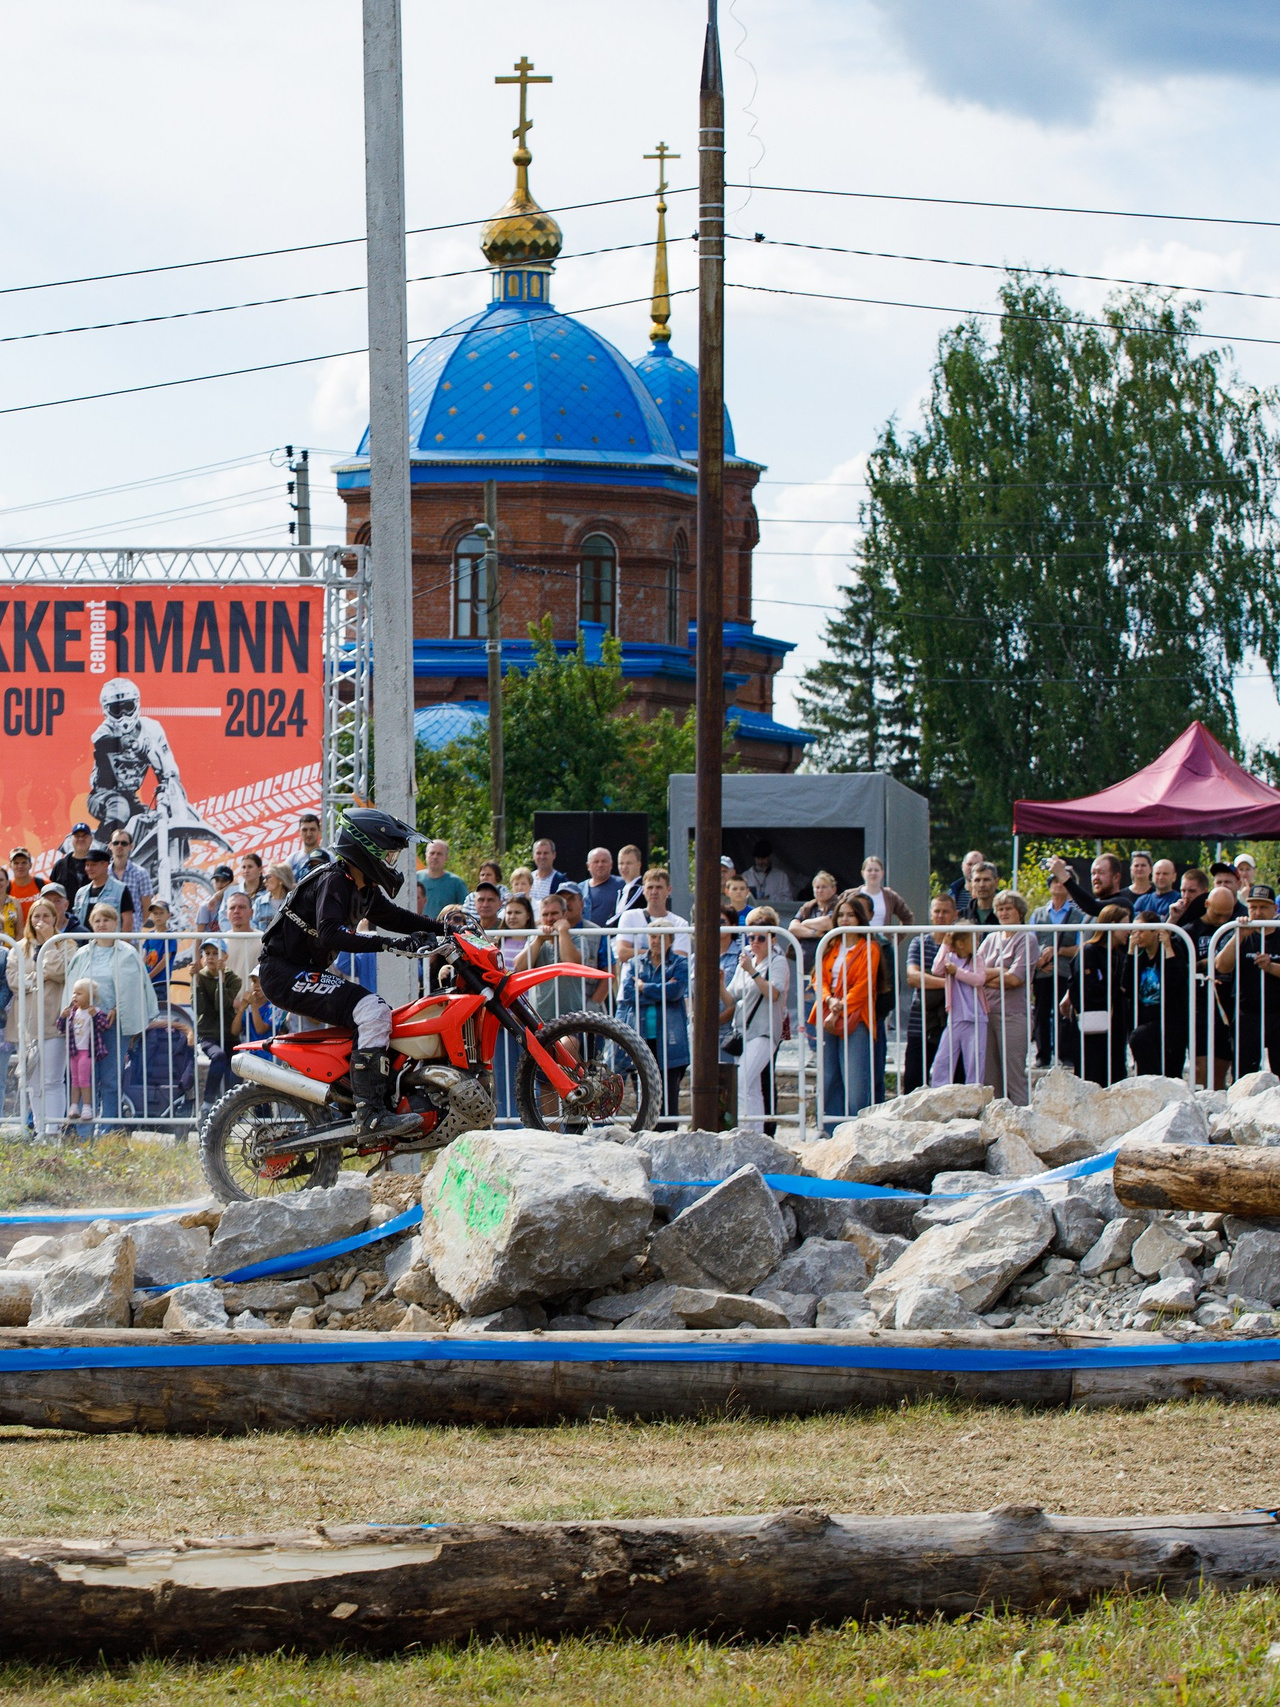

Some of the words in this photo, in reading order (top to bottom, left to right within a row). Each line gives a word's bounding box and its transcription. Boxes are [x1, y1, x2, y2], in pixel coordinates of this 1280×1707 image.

[86, 600, 107, 674] cement
[3, 687, 65, 737] CUP
[225, 688, 308, 737] 2024
[291, 980, 341, 995] SHOT
